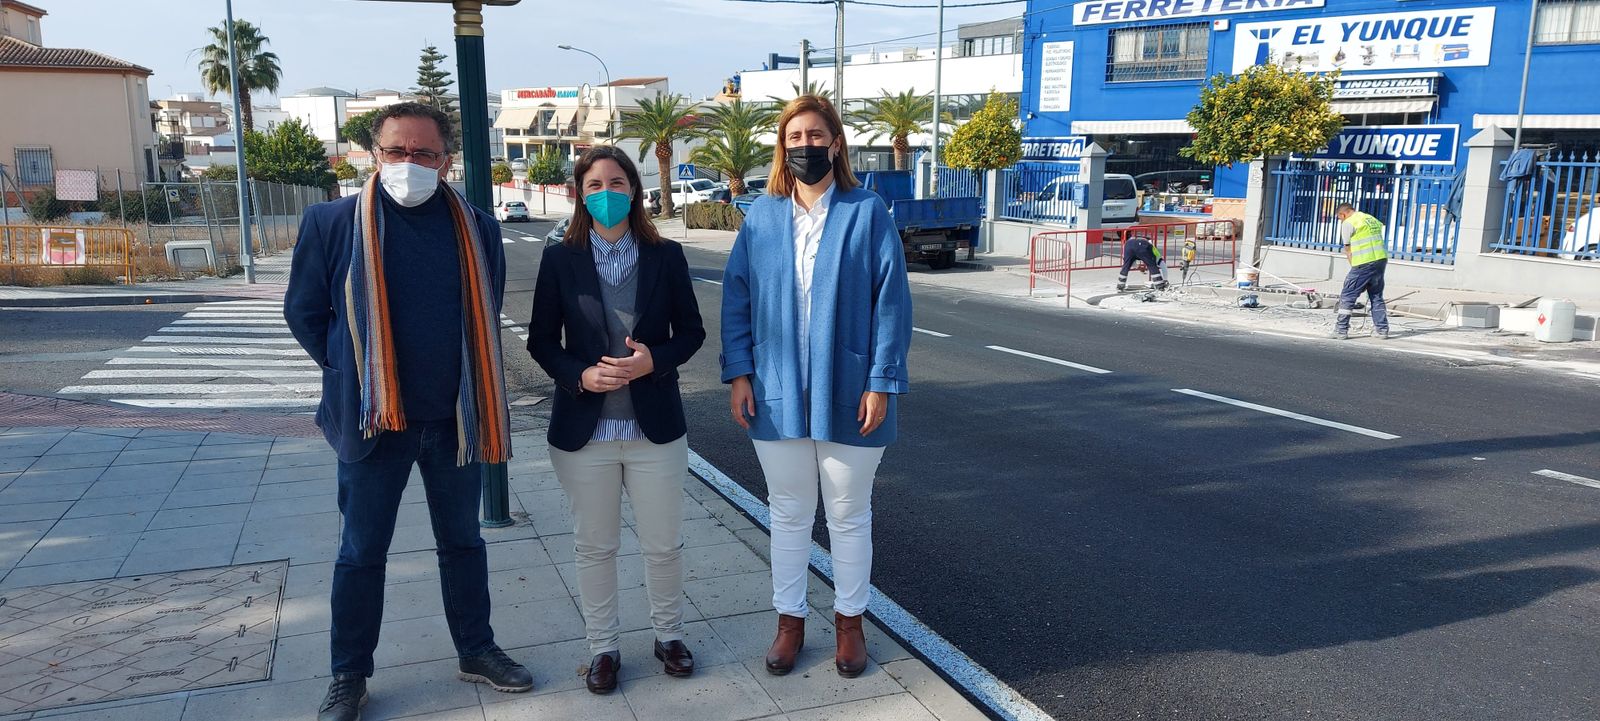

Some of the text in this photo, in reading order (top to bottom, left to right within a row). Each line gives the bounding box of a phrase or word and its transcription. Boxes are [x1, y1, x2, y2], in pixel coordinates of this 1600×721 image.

[1292, 15, 1474, 45] EL YUNQUE
[1345, 79, 1429, 89] INDUSTRIAL
[1338, 133, 1442, 158] YUNQUE
